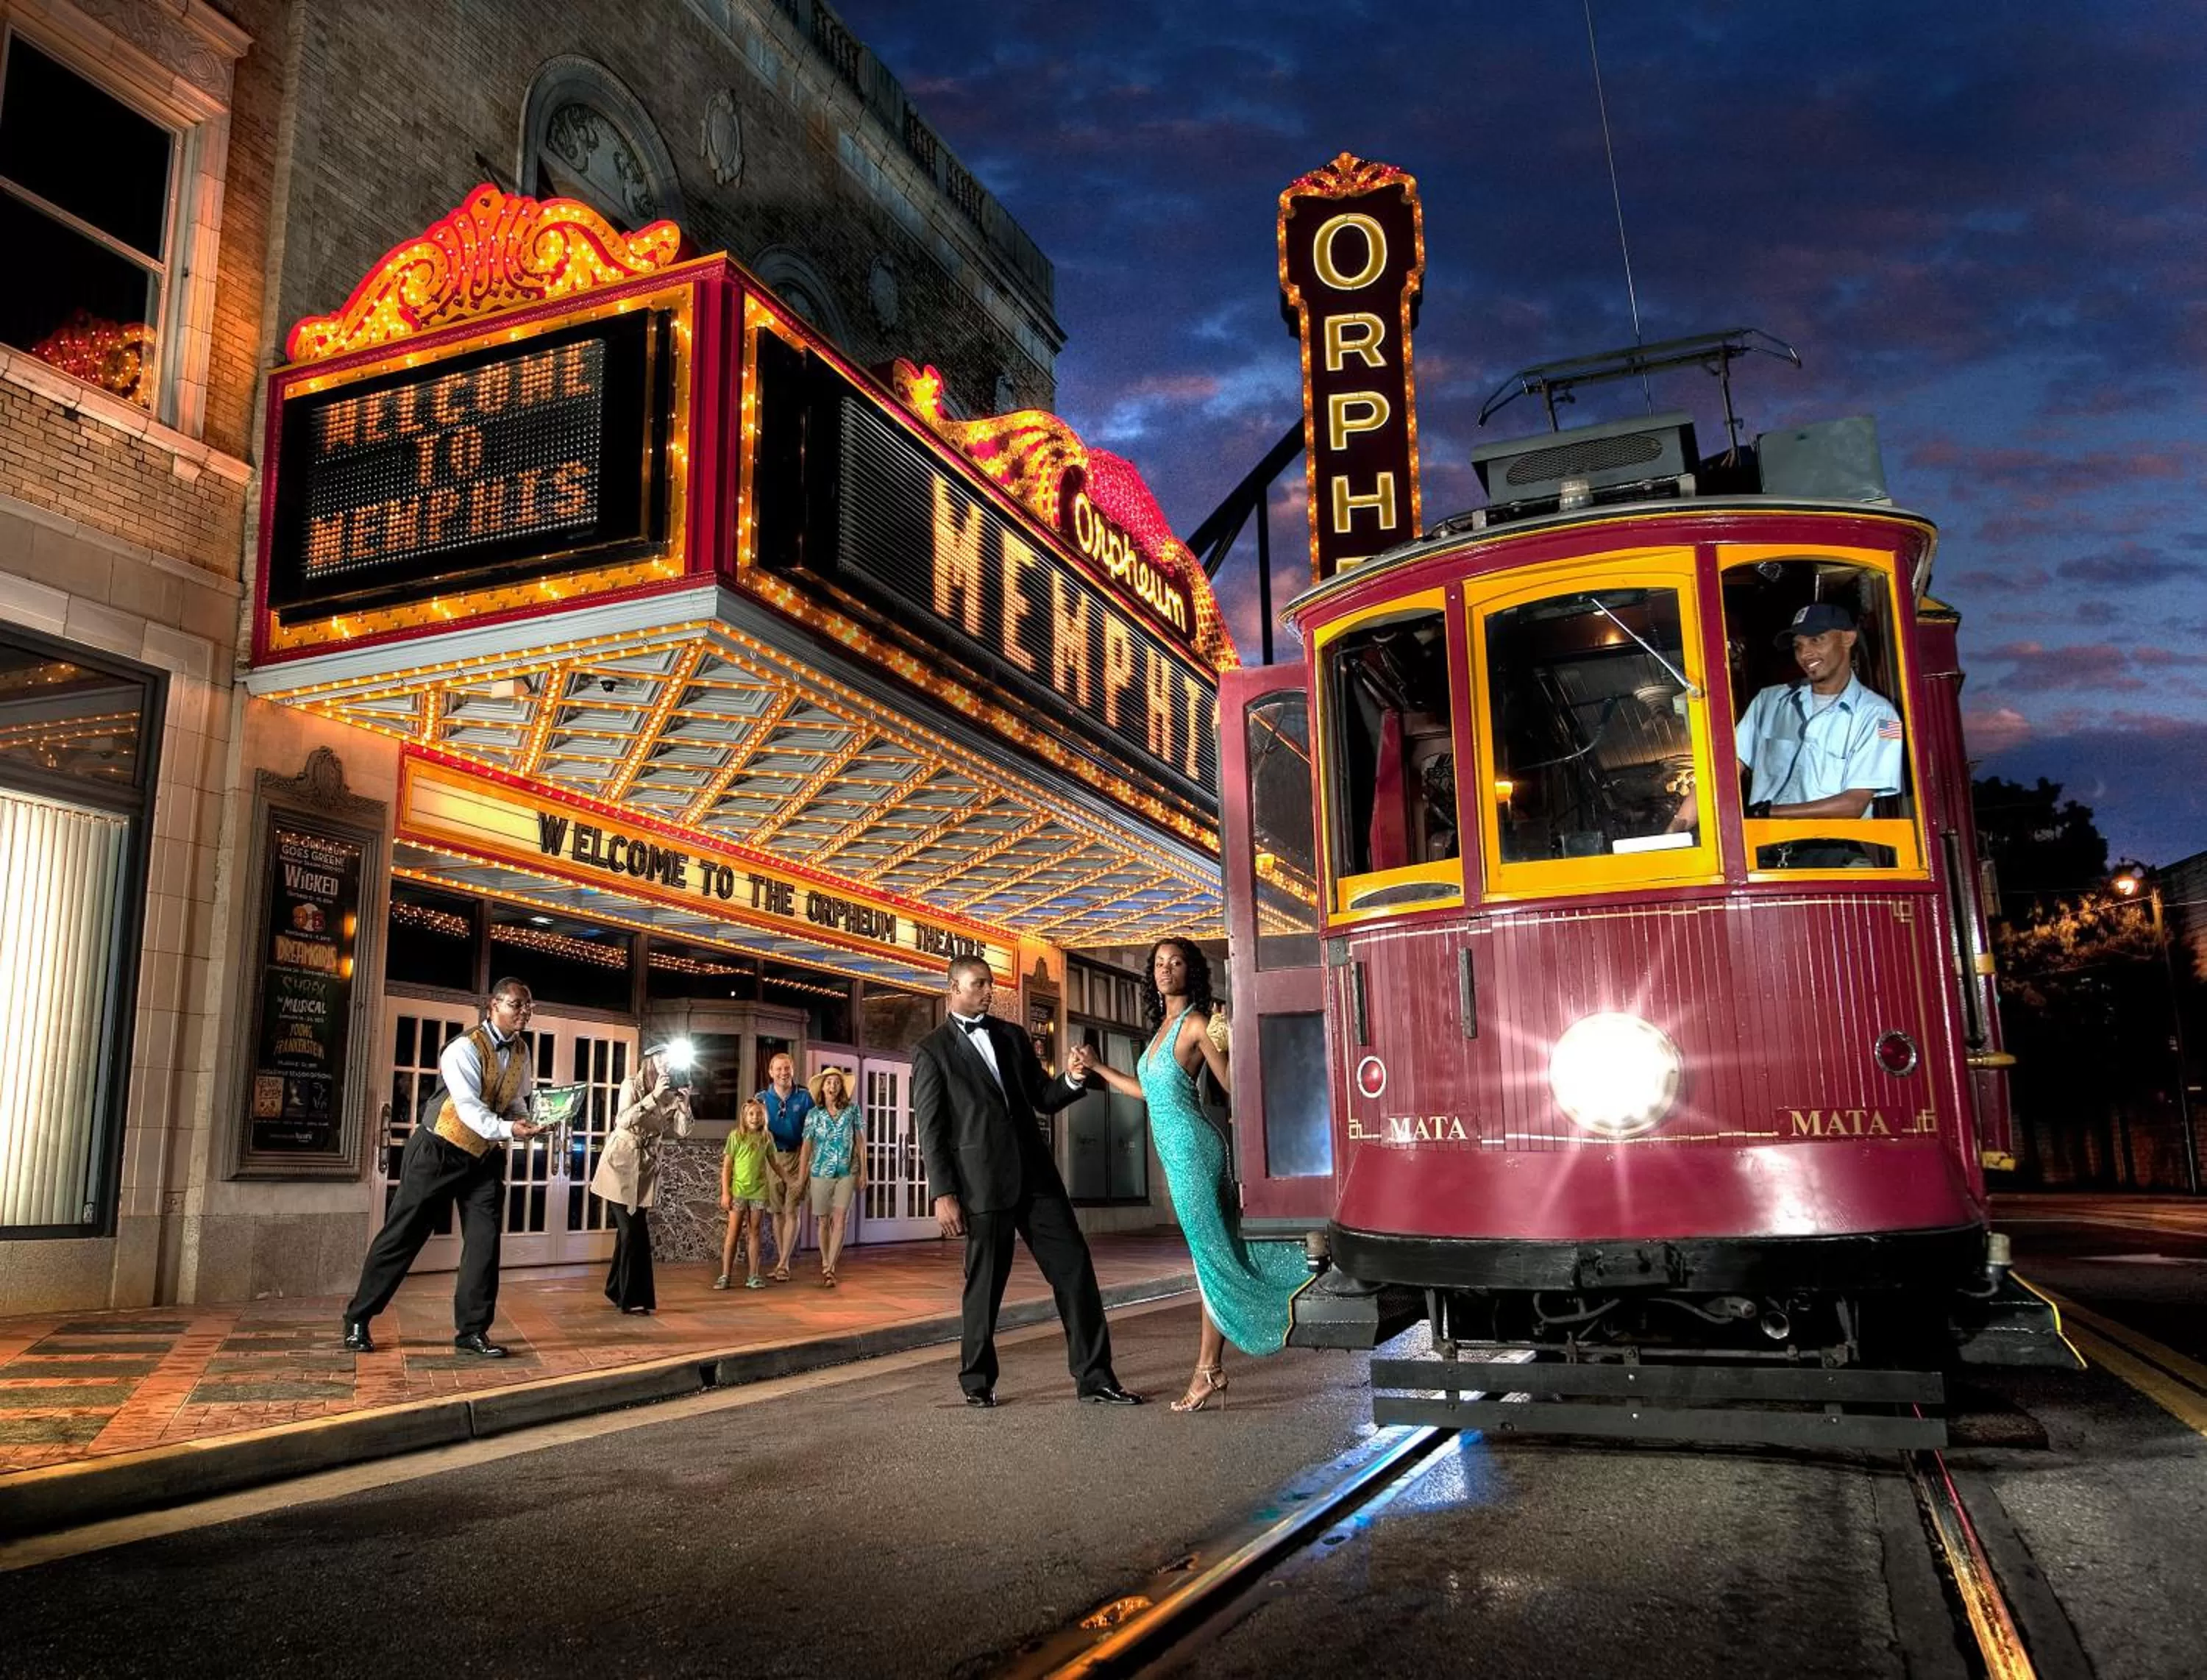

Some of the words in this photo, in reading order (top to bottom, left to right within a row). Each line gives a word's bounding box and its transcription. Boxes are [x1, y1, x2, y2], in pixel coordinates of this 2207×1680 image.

[319, 340, 591, 454] WELCOME
[413, 424, 484, 486] TO
[307, 459, 589, 566] MEMPHIS
[1073, 492, 1189, 635] Orpheum
[931, 471, 1220, 782] MEMPHI
[282, 844, 309, 858] GOES
[539, 811, 689, 889] WELCOME
[699, 859, 734, 900] TO
[747, 872, 796, 917] THE
[806, 890, 897, 944] ORPHEUM
[913, 920, 986, 960] THEATRE
[1387, 1116, 1468, 1143] MATA
[1788, 1109, 1891, 1136] MATA
